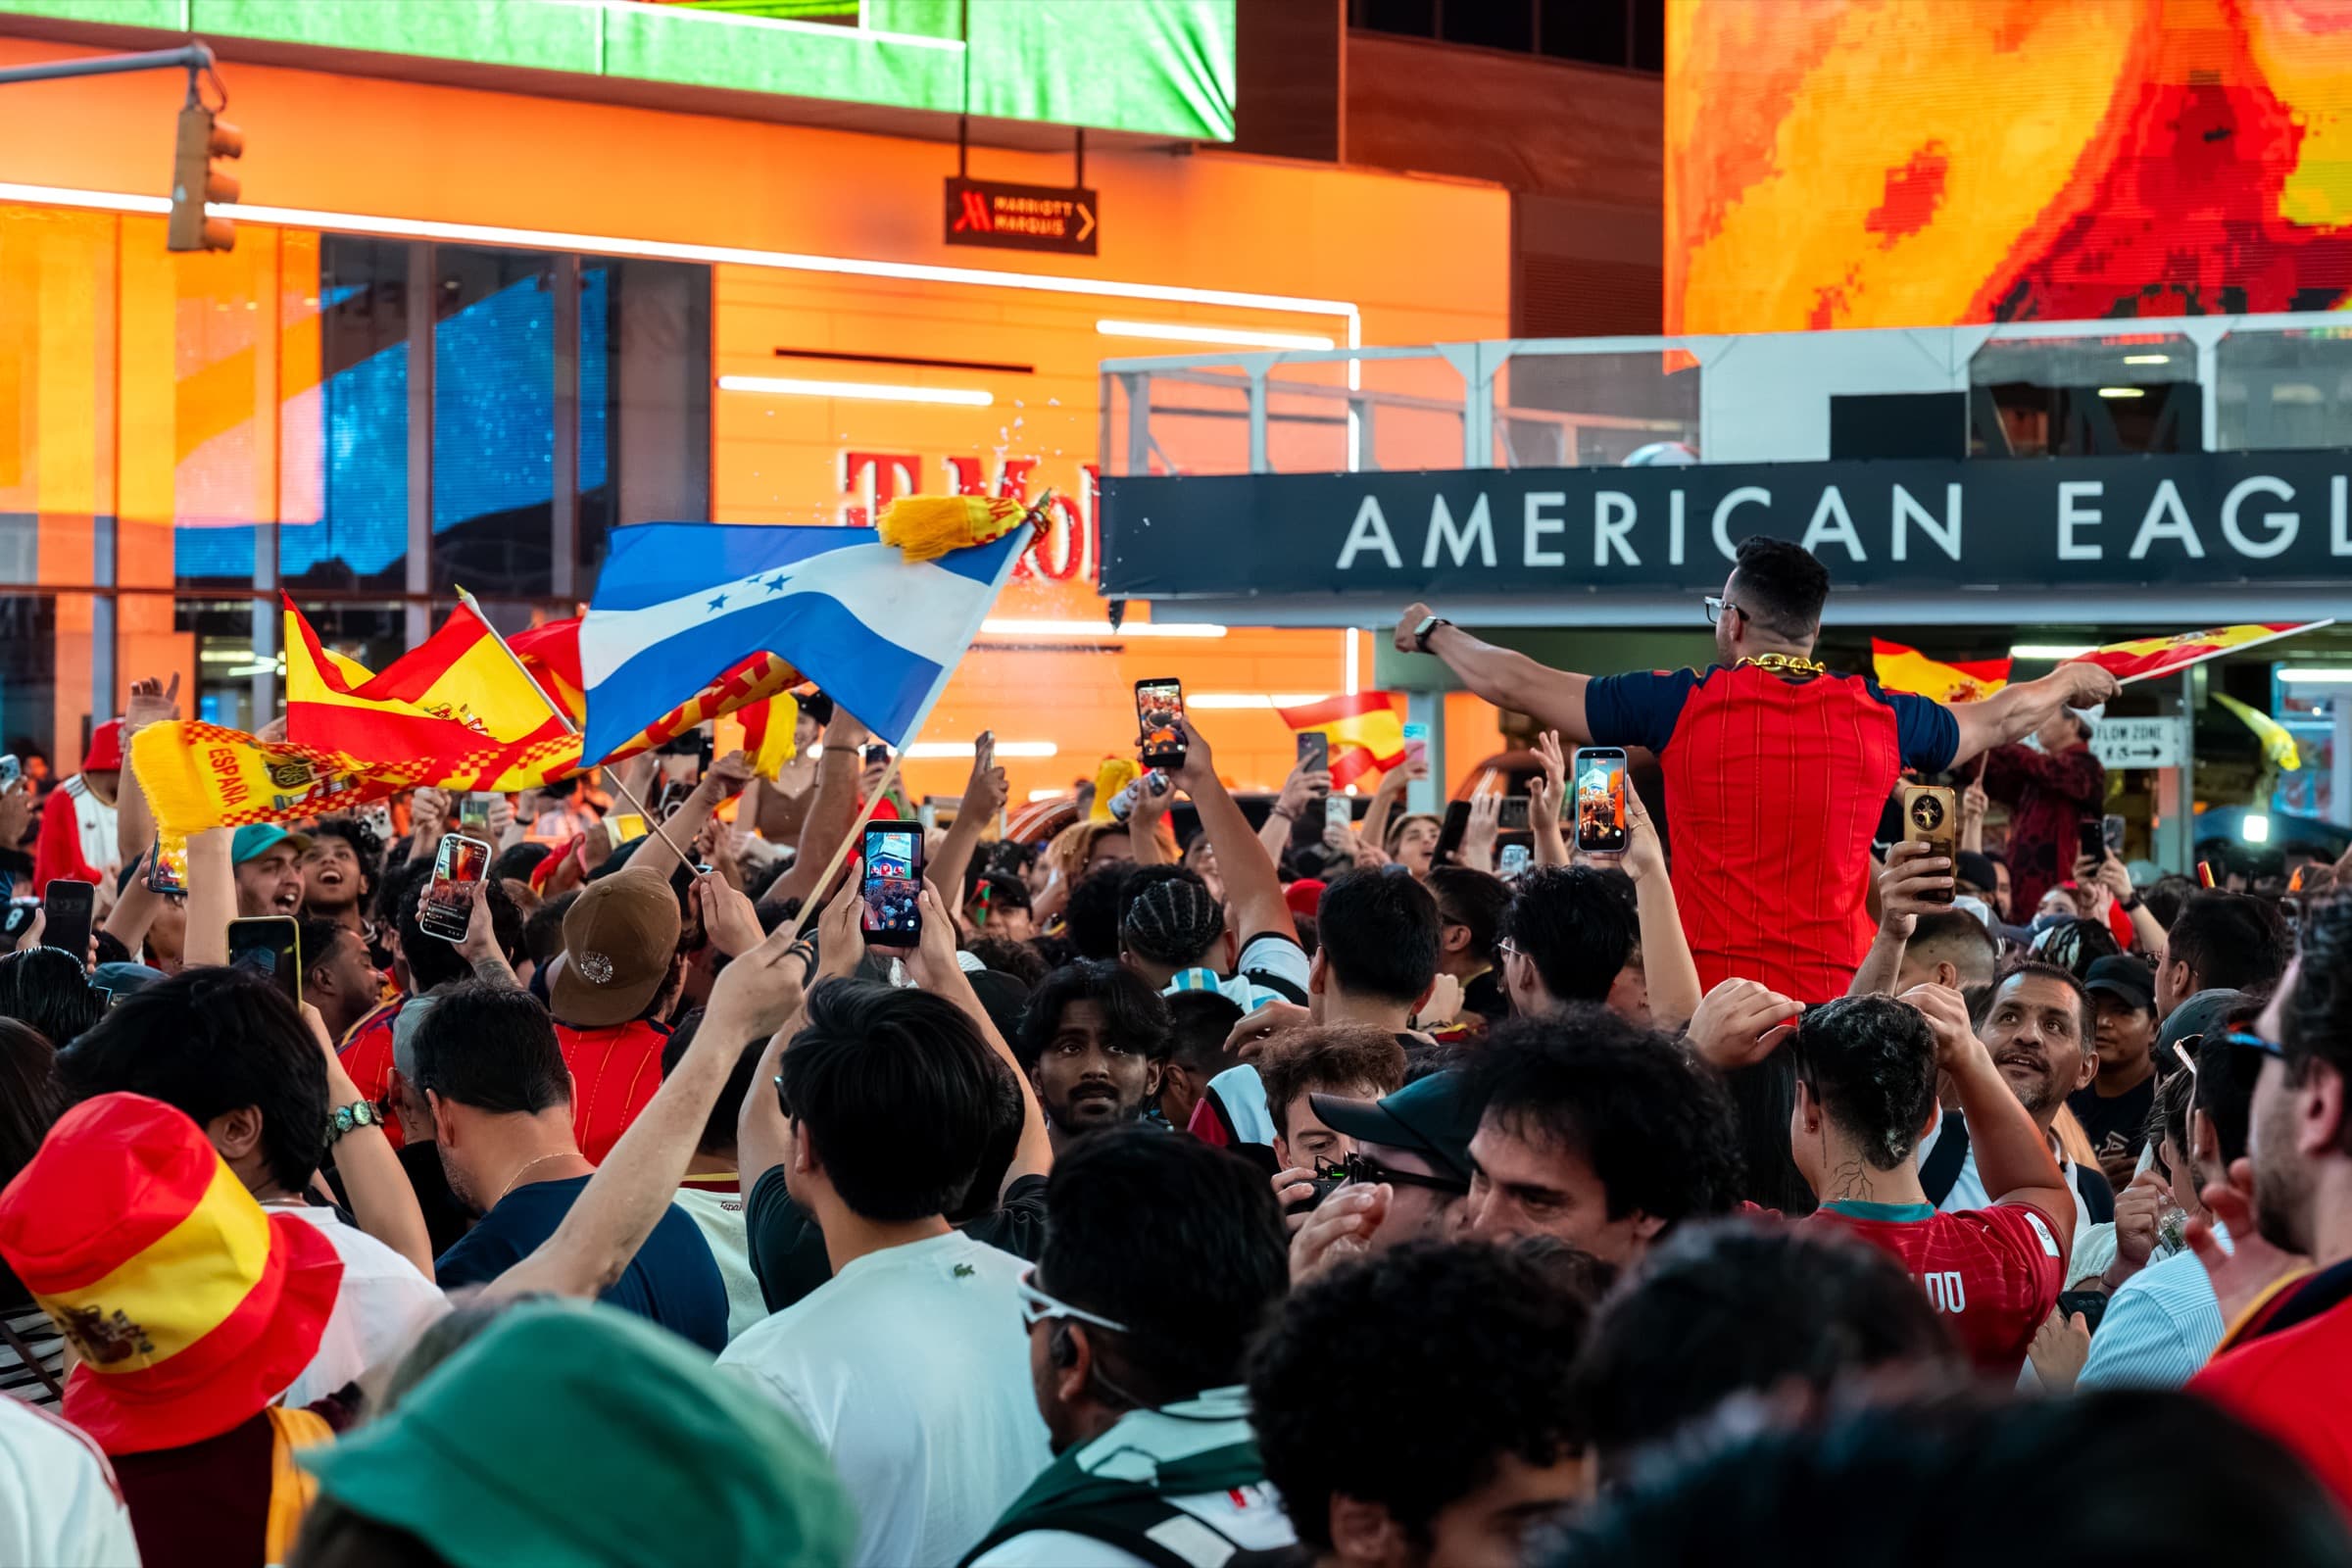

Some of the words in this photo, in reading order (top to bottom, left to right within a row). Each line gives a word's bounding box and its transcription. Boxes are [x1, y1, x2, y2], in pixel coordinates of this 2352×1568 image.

[994, 196, 1073, 217] MARRIOTT
[994, 214, 1065, 236] MARQUIS
[1336, 482, 1963, 569] AMERICAN
[2058, 475, 2352, 560] EAGL
[2132, 725, 2163, 742] ZONE
[209, 748, 249, 808] ESPAÑA
